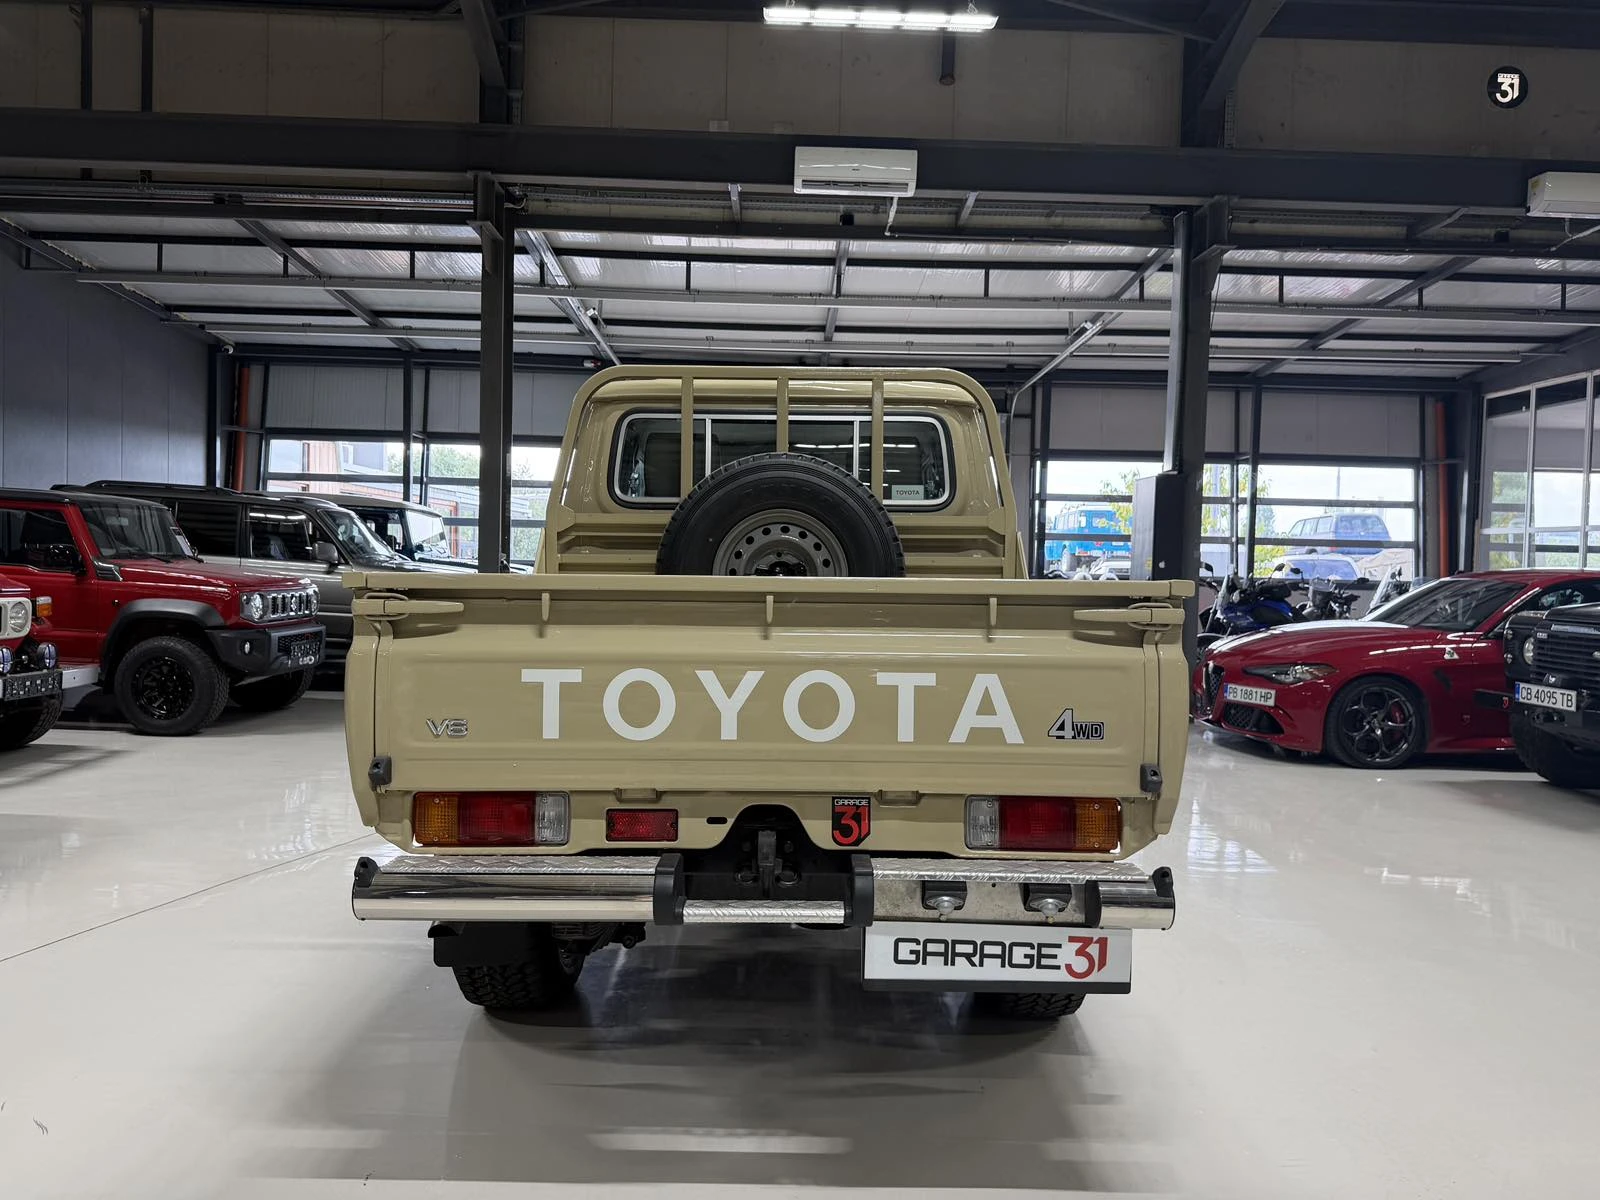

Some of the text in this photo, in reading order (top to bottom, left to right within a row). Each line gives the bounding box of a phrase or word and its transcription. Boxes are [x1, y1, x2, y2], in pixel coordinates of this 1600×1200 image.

[1496, 78, 1520, 103] 31
[520, 667, 1025, 745] TOYOTA
[1259, 690, 1273, 703] HP
[1520, 686, 1573, 708] CB 4095 TB
[1048, 708, 1104, 740] 4WD
[833, 805, 869, 845] 31
